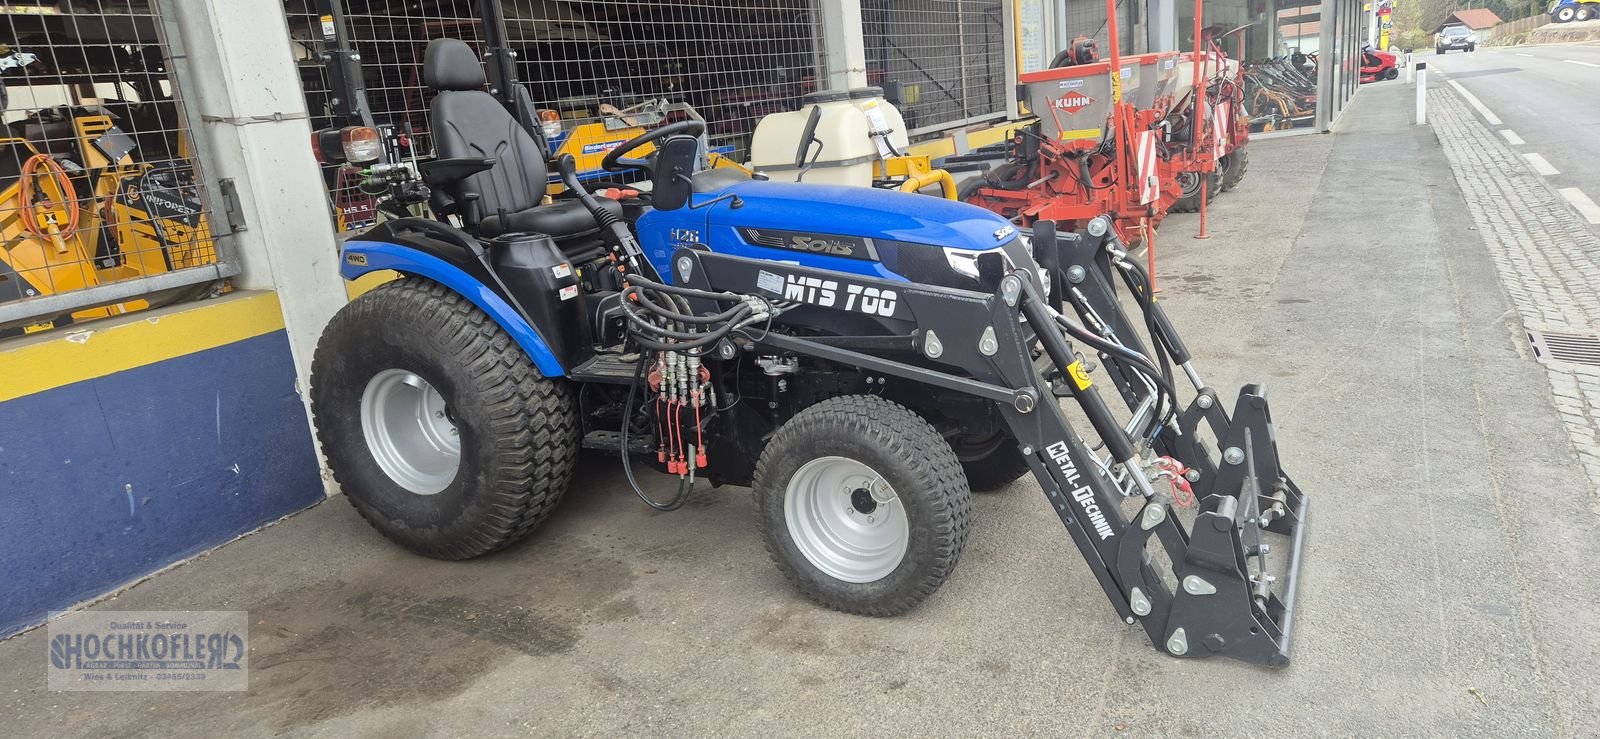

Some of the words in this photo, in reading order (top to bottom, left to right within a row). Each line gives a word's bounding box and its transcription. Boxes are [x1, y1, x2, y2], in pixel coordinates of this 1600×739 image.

[1055, 97, 1090, 108] KUHN
[348, 255, 365, 263] 4WD
[785, 274, 838, 307] MTS
[845, 284, 898, 317] 700
[1045, 440, 1115, 540] METAL-TECHNIK
